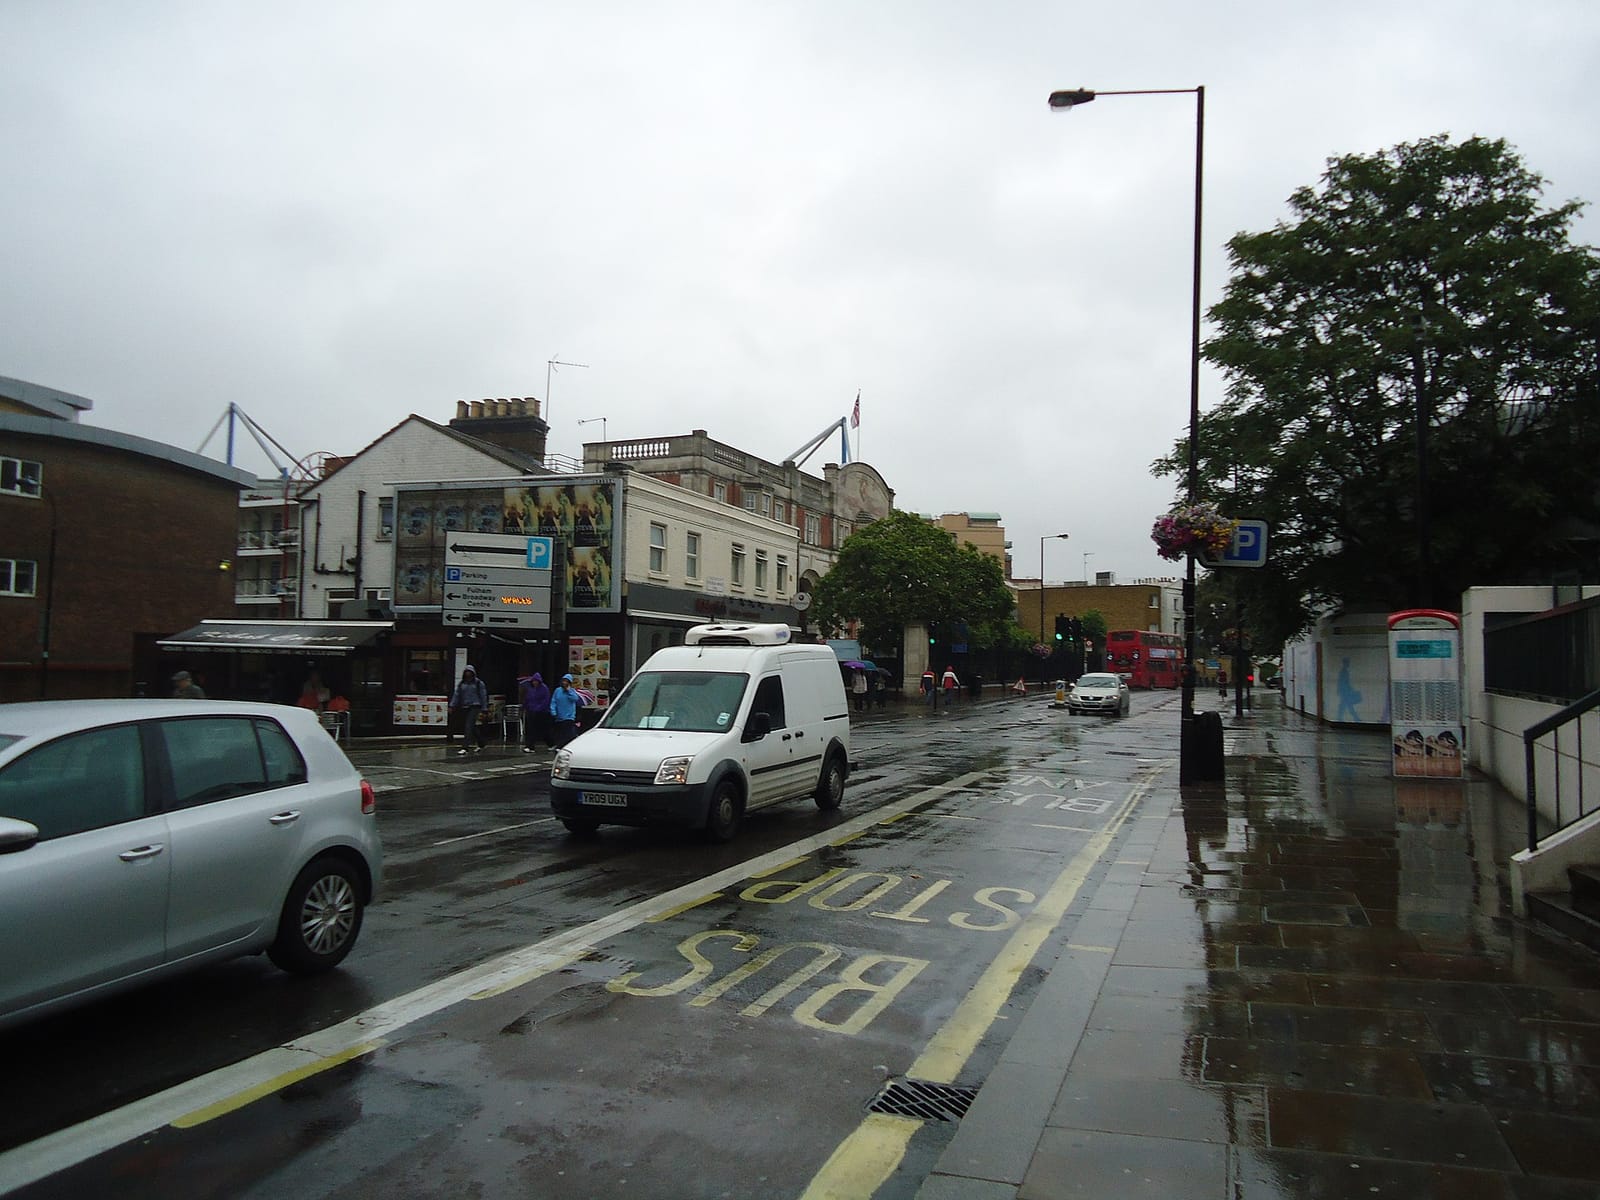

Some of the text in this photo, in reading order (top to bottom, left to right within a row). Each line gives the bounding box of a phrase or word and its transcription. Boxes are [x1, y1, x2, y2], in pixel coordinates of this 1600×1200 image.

[531, 541, 547, 564] P
[1233, 528, 1256, 557] P
[450, 569, 488, 580] P Parking
[462, 594, 496, 602] Broadway
[583, 793, 627, 806] YR09 UGX
[988, 791, 1114, 814] BUS
[739, 868, 1036, 931] STOP
[607, 930, 931, 1035] BUS
